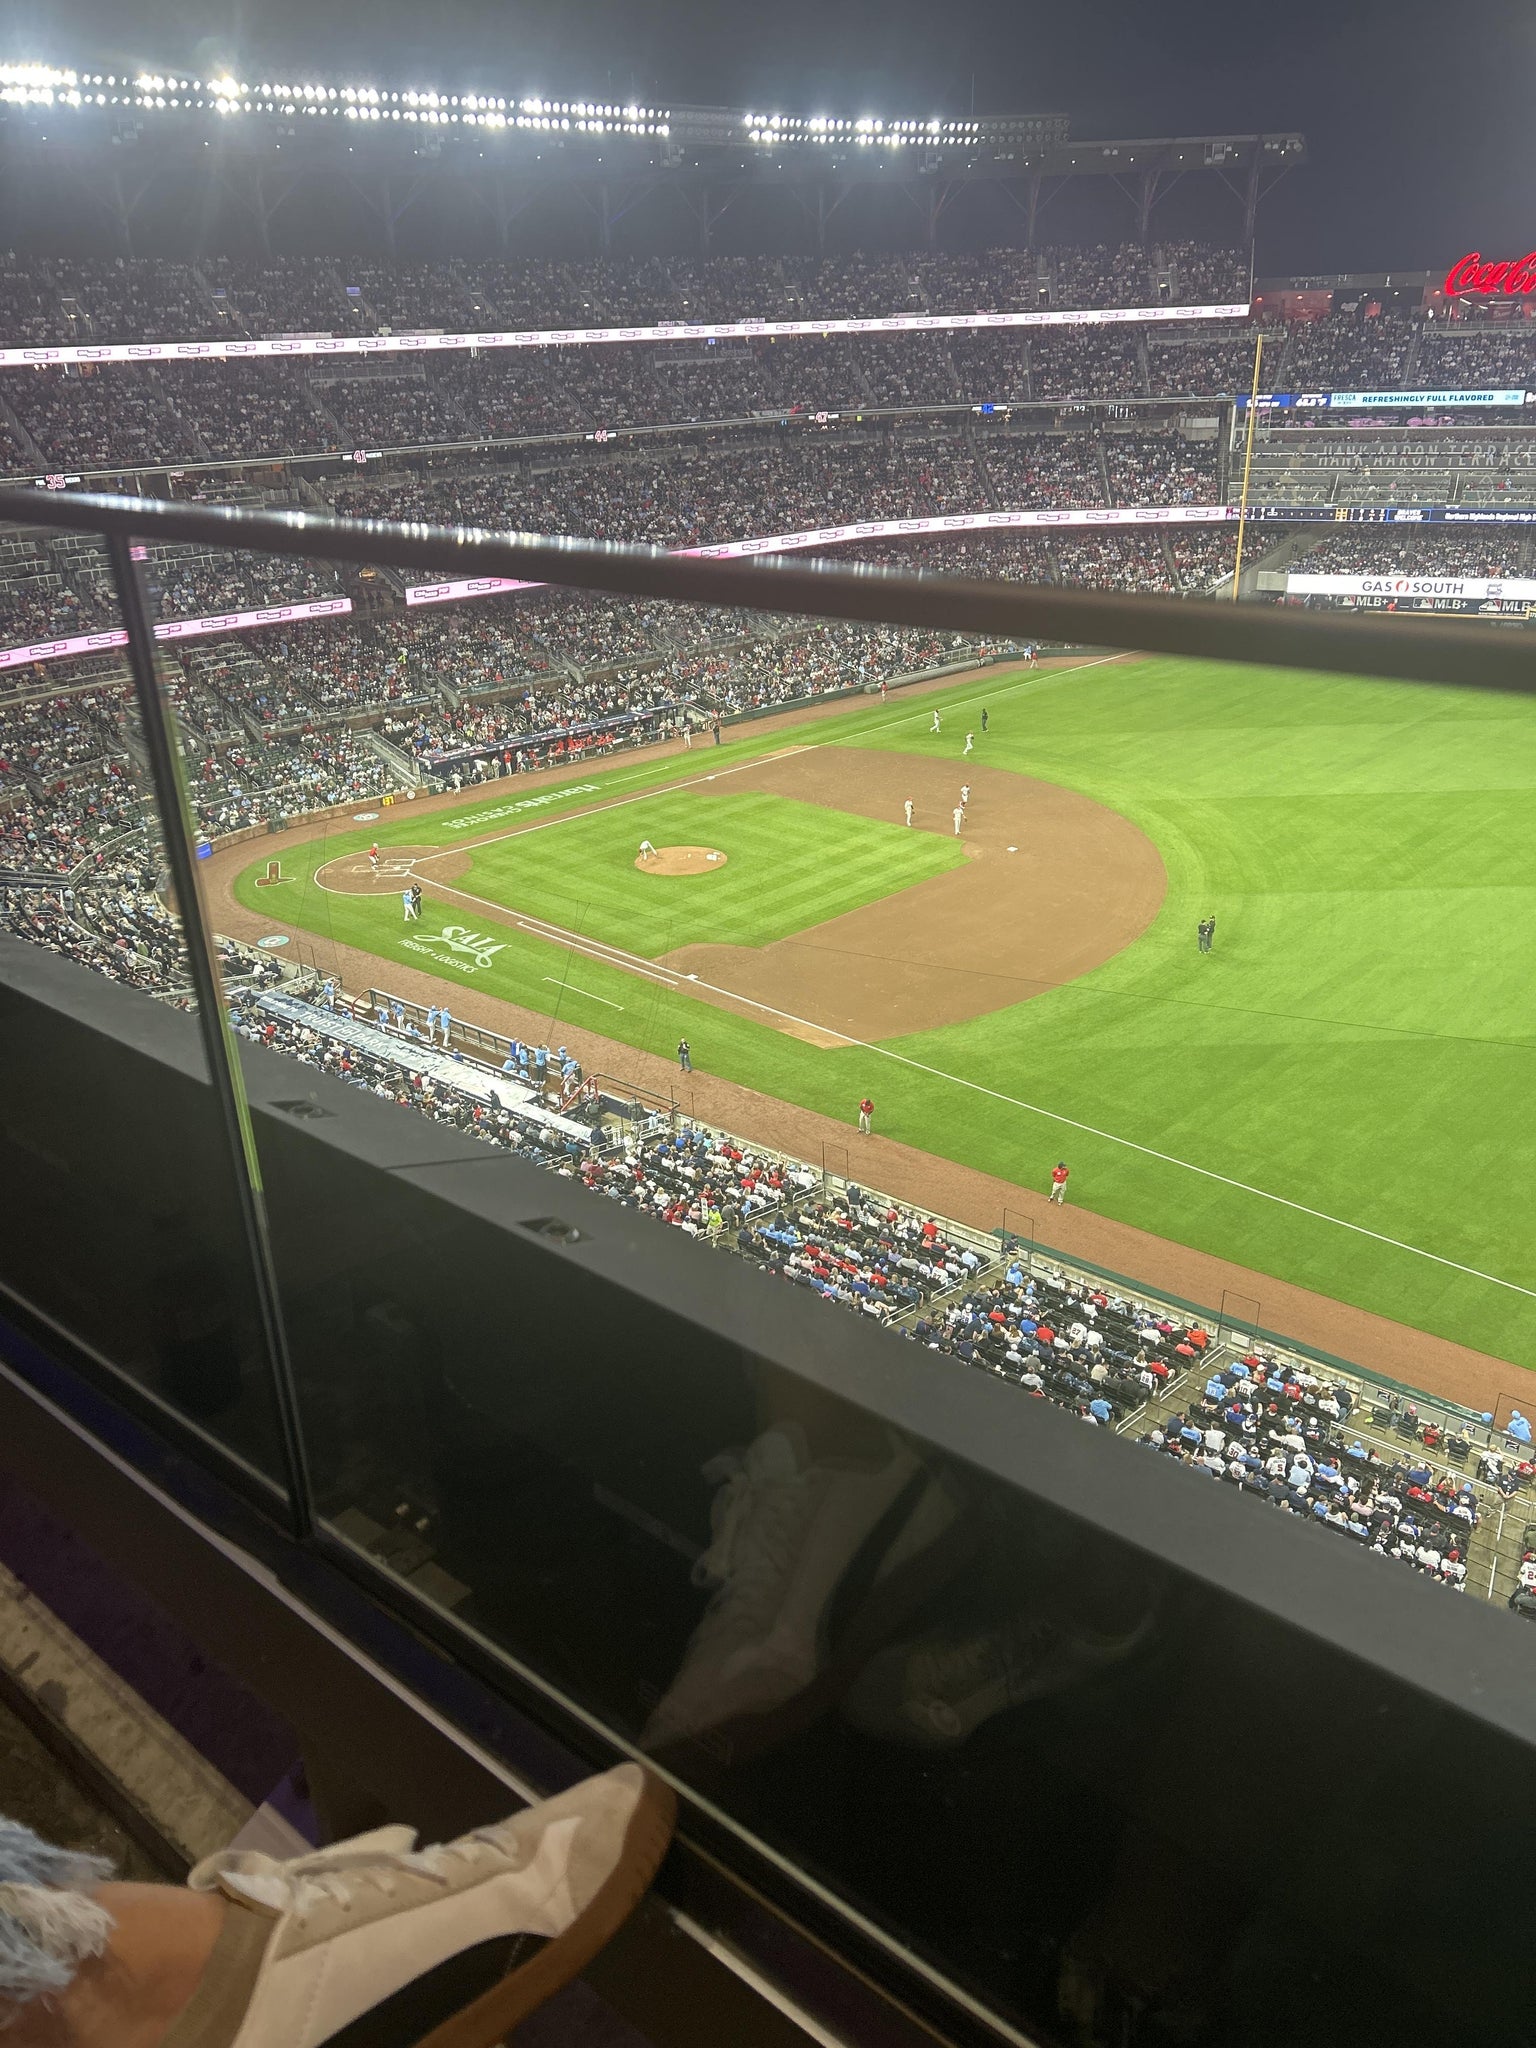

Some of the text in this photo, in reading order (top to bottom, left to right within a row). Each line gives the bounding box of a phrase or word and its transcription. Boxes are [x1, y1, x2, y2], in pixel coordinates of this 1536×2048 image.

[1362, 394, 1494, 403] REFRESHINGLY FULL FLAVORED
[353, 450, 367, 463] 41
[1319, 444, 1536, 467] HANK AARON TERRACE
[45, 474, 66, 489] 35
[1362, 581, 1464, 594] GAS SOUTH
[1356, 596, 1388, 608] MLB+
[1434, 598, 1468, 610] MLB+
[1502, 600, 1533, 612] MLB
[413, 925, 508, 968] SAIA
[397, 938, 478, 974] FREIGHT LOGISTICS
[300, 1010, 387, 1050] TRUIST PARK
[1072, 1327, 1082, 1336] 27
[1228, 1447, 1240, 1459] 30
[1277, 1464, 1283, 1472] 5
